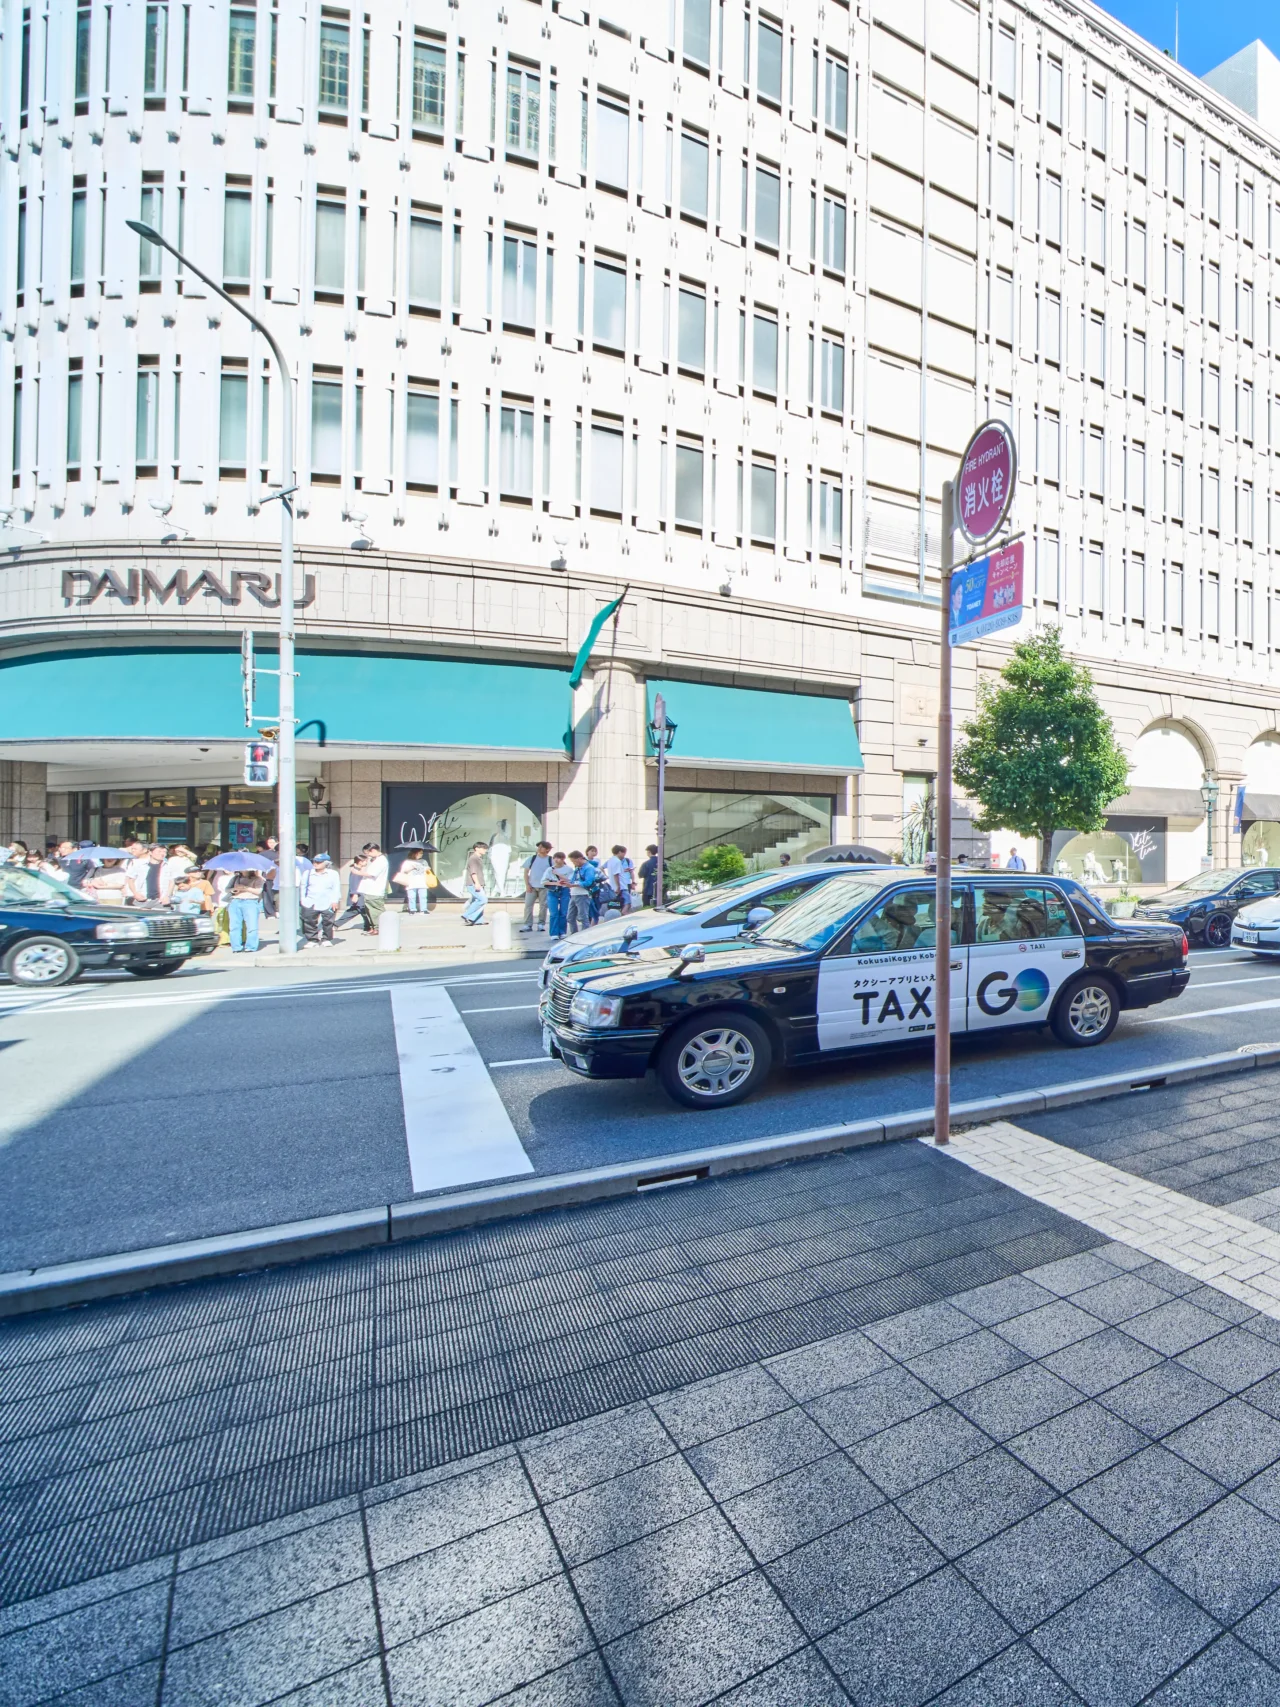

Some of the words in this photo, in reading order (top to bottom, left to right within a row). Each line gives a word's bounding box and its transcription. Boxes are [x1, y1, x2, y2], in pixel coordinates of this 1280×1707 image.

[965, 458, 977, 474] FIRE
[978, 441, 1004, 467] HYDRANT
[964, 467, 1004, 518] 消火栓
[61, 568, 316, 607] DAIMARU
[857, 955, 917, 966] KokusaiKogyo
[976, 968, 1050, 1016] GO
